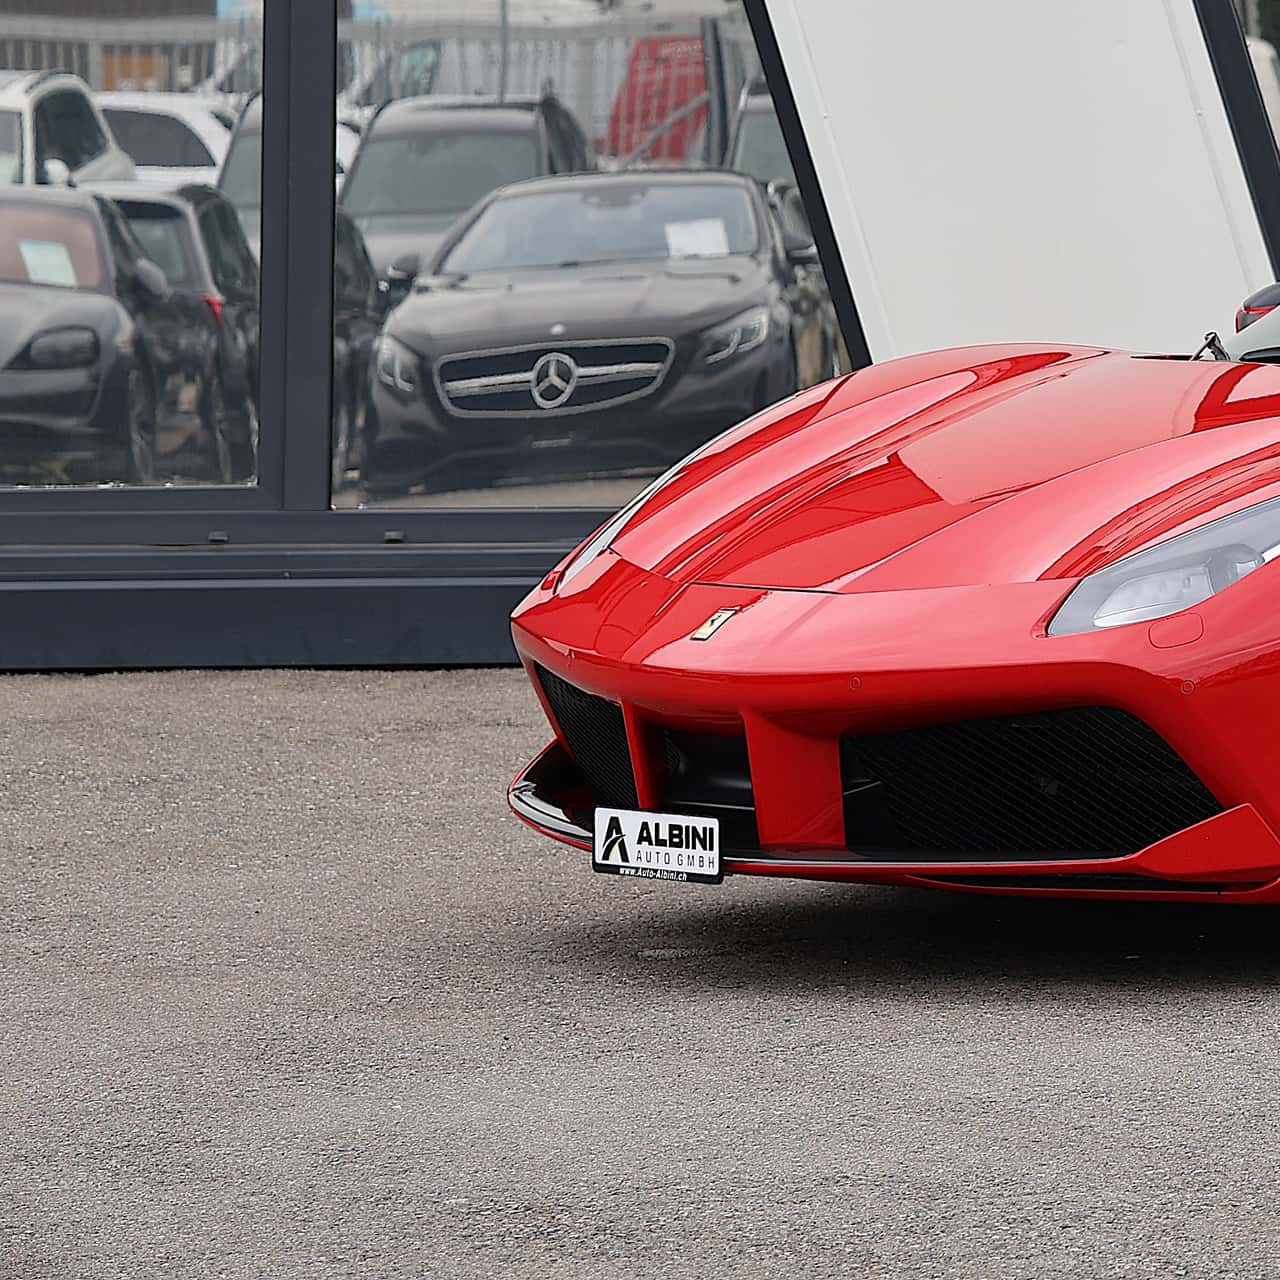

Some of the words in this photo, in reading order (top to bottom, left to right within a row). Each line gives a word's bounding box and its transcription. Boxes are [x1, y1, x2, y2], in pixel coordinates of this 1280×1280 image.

[636, 821, 715, 852] ALBINI
[636, 850, 671, 865] AUTO
[677, 853, 715, 870] GMBH
